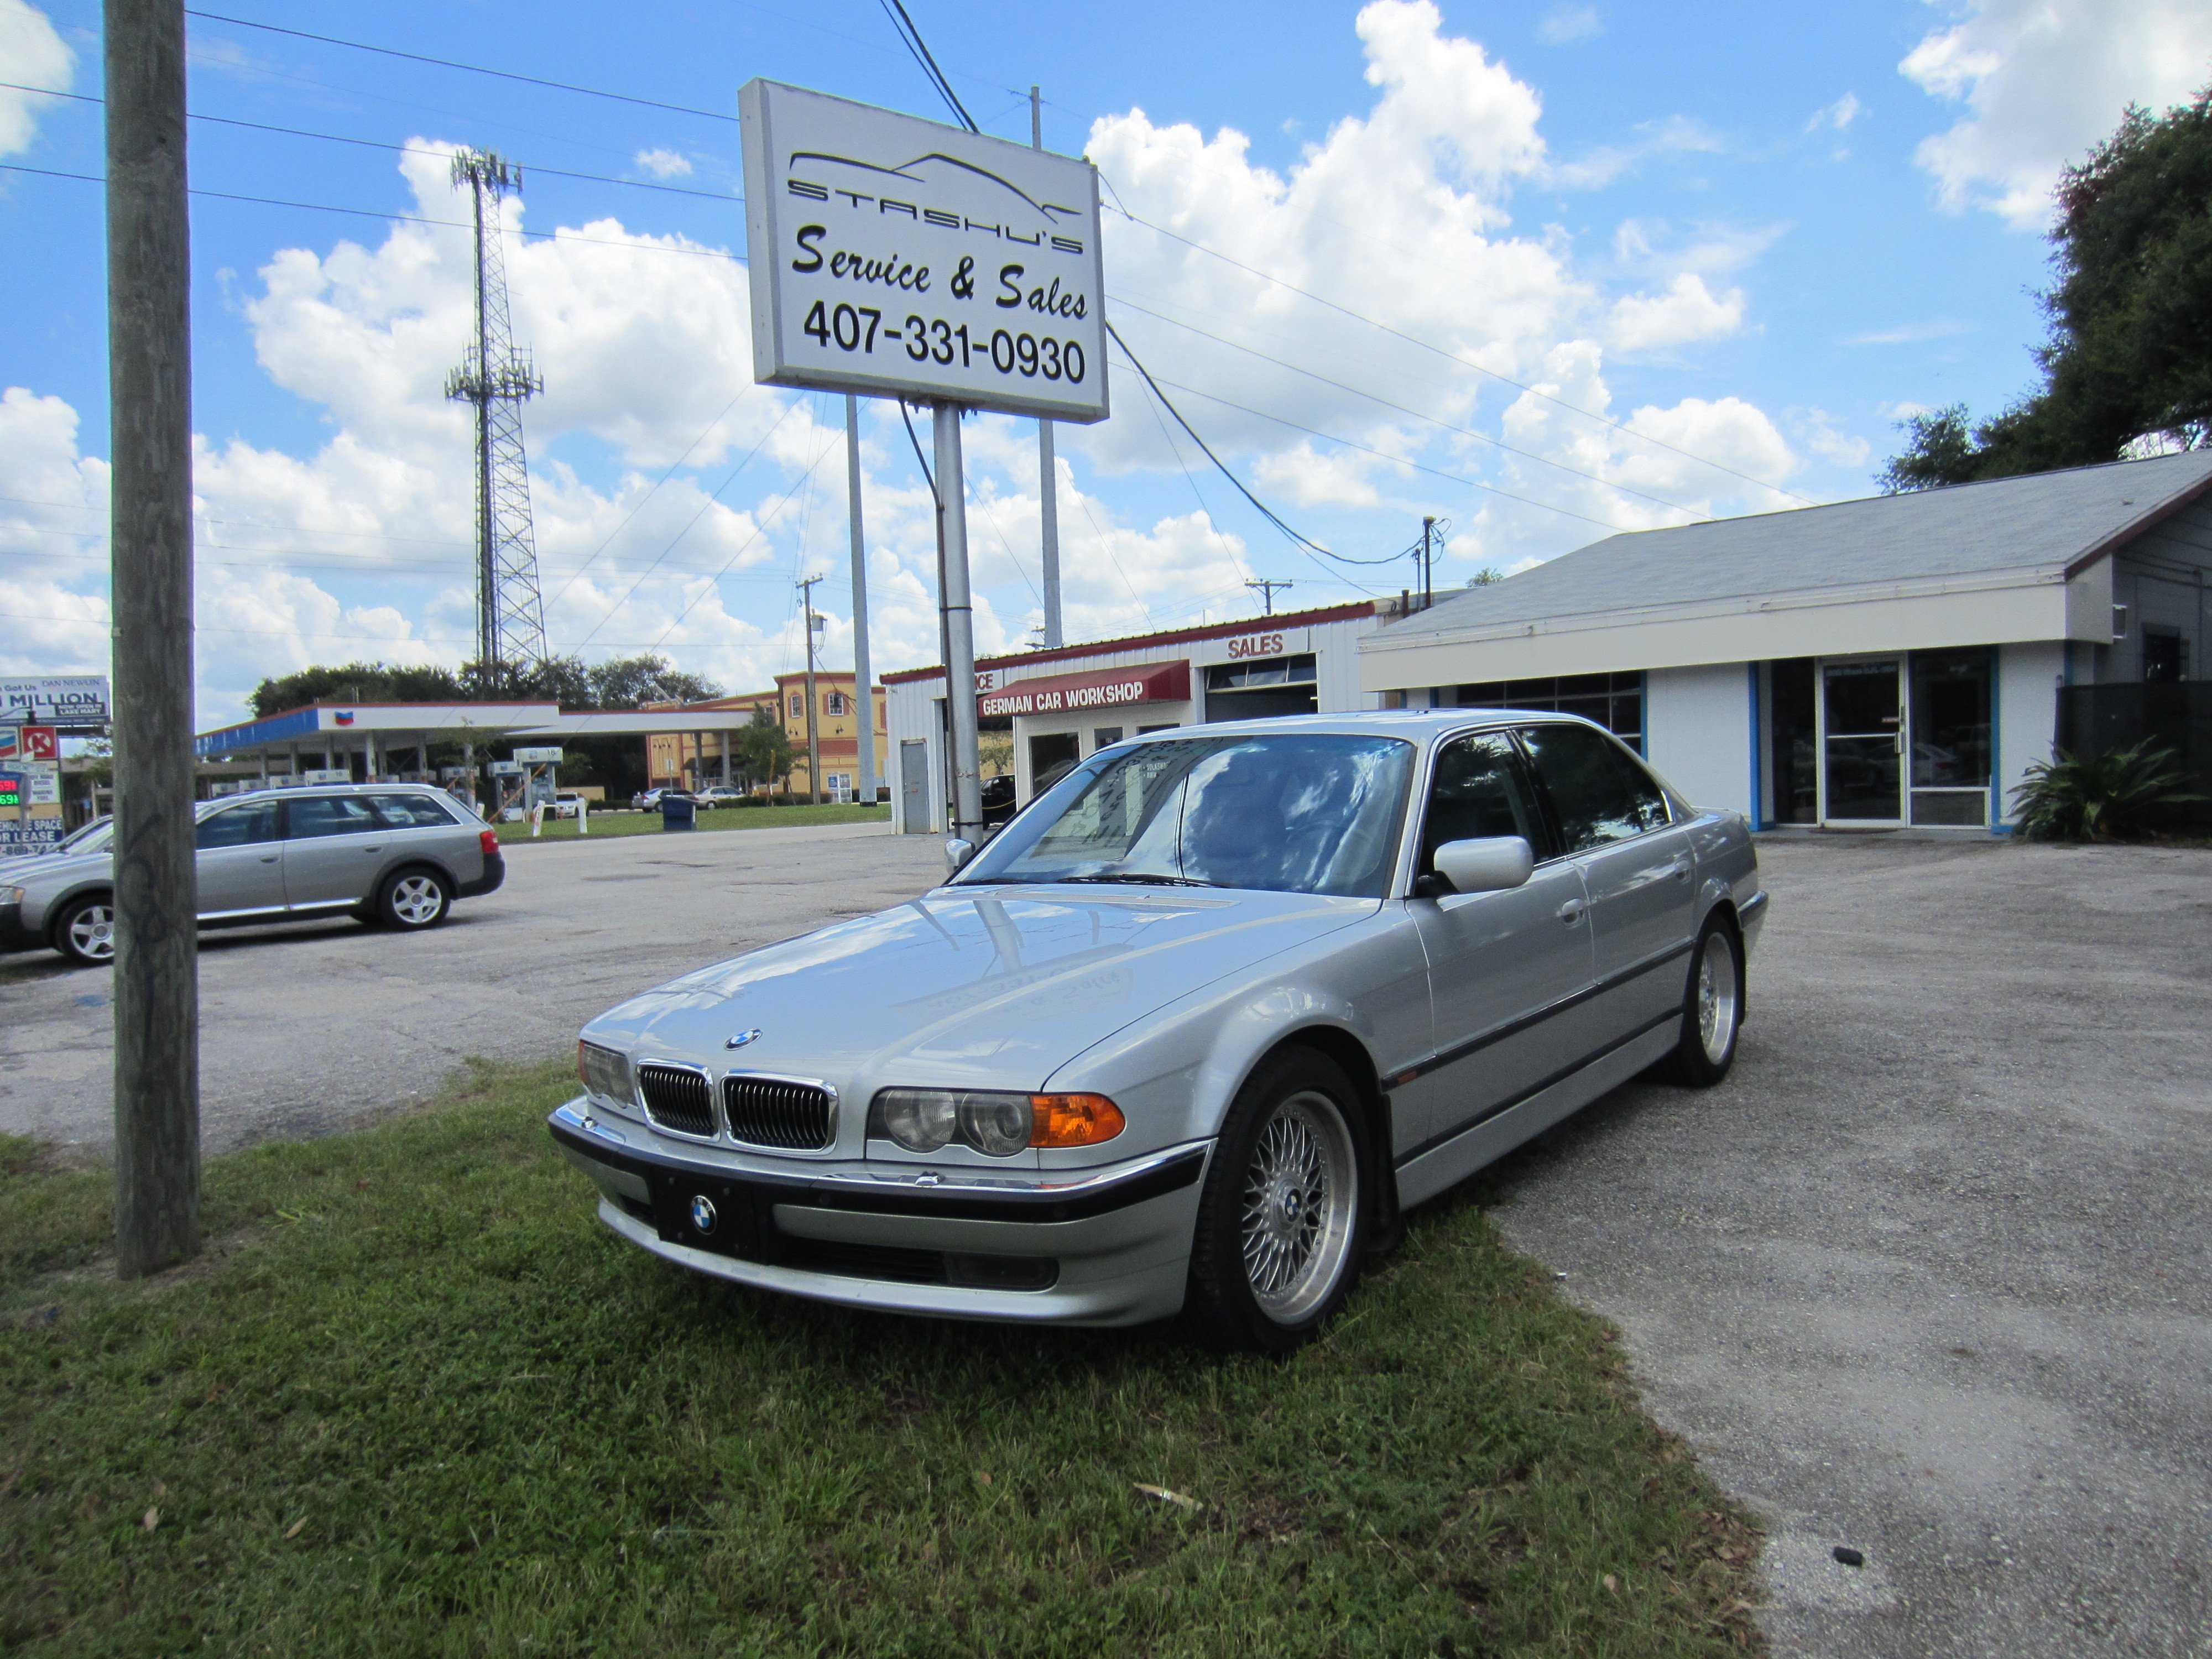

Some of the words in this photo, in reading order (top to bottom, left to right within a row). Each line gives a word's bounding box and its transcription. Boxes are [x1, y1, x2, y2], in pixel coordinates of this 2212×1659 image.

[787, 179, 1084, 255] STASHU'S
[792, 224, 932, 293] Service
[950, 255, 975, 300] &
[995, 263, 1088, 320] Sales
[804, 299, 1086, 384] 407-331-0930
[1228, 633, 1284, 659] SALES
[9, 692, 98, 707] MILLION
[983, 695, 1033, 716] GERMAN
[1036, 691, 1062, 710] CAR
[1065, 681, 1143, 708] WORKSHOP
[14, 831, 55, 842] LEASE
[34, 820, 62, 830] SPACE
